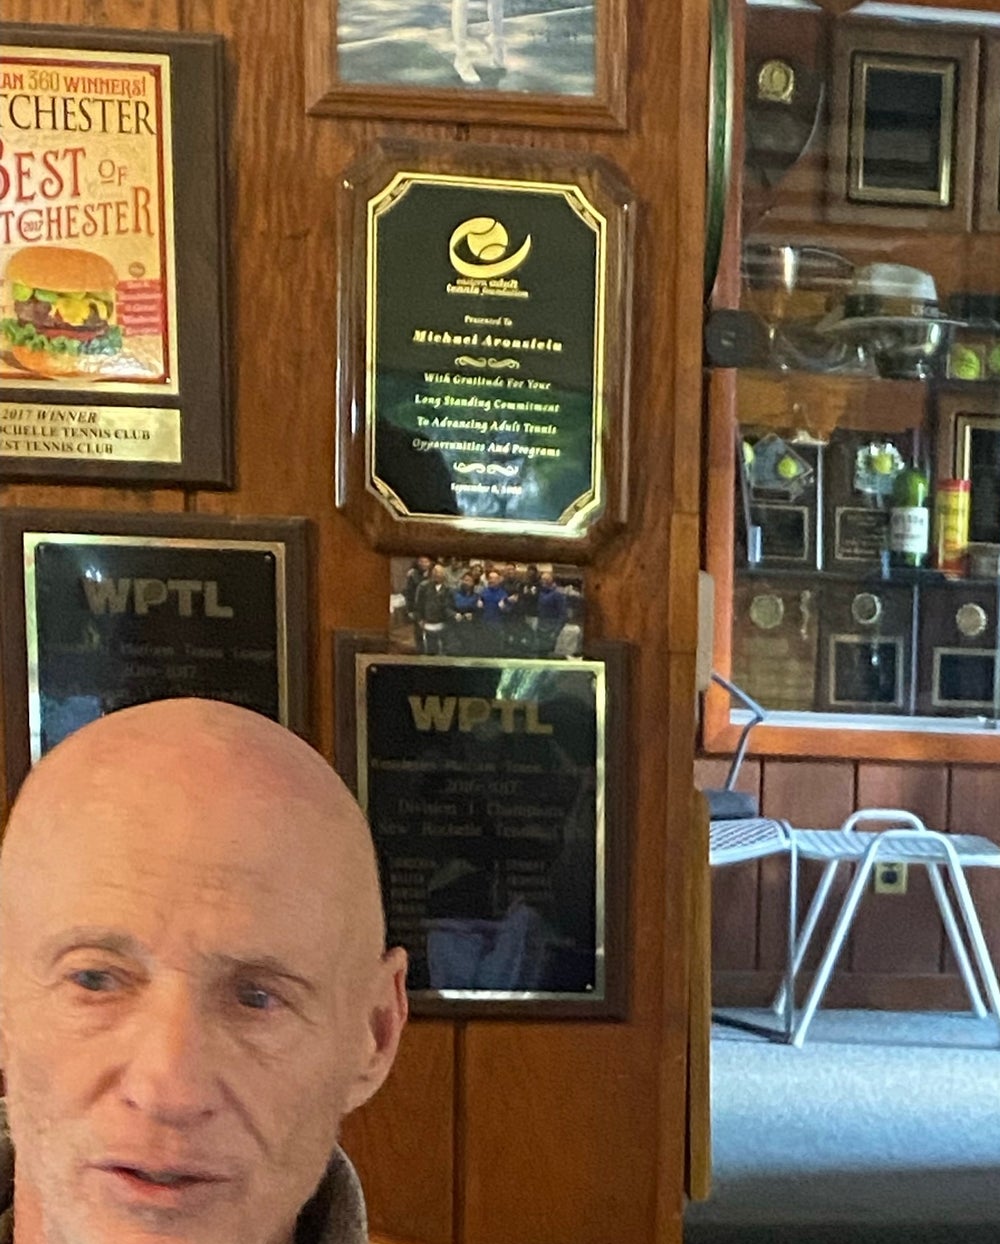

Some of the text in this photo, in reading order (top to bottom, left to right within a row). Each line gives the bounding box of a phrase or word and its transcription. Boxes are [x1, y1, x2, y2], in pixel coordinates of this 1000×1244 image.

[0, 70, 146, 98] AN 360 WINNERS!
[23, 220, 44, 233] 2017
[412, 330, 479, 345] Michael
[424, 372, 450, 384] With
[507, 378, 524, 389] For
[527, 379, 551, 390] Your
[414, 394, 560, 413] Long Standing Commitment
[2, 408, 98, 424] 2017 WINNER
[416, 416, 430, 427] To
[431, 416, 488, 433] Advancing
[490, 420, 521, 432] Adult
[62, 426, 111, 440] TENNIS
[114, 428, 150, 441] CLUB
[26, 440, 74, 453] TENNIS
[76, 443, 114, 455] CLUB
[488, 442, 510, 454] And
[79, 577, 234, 619] WPTL
[408, 695, 553, 734] WPTL
